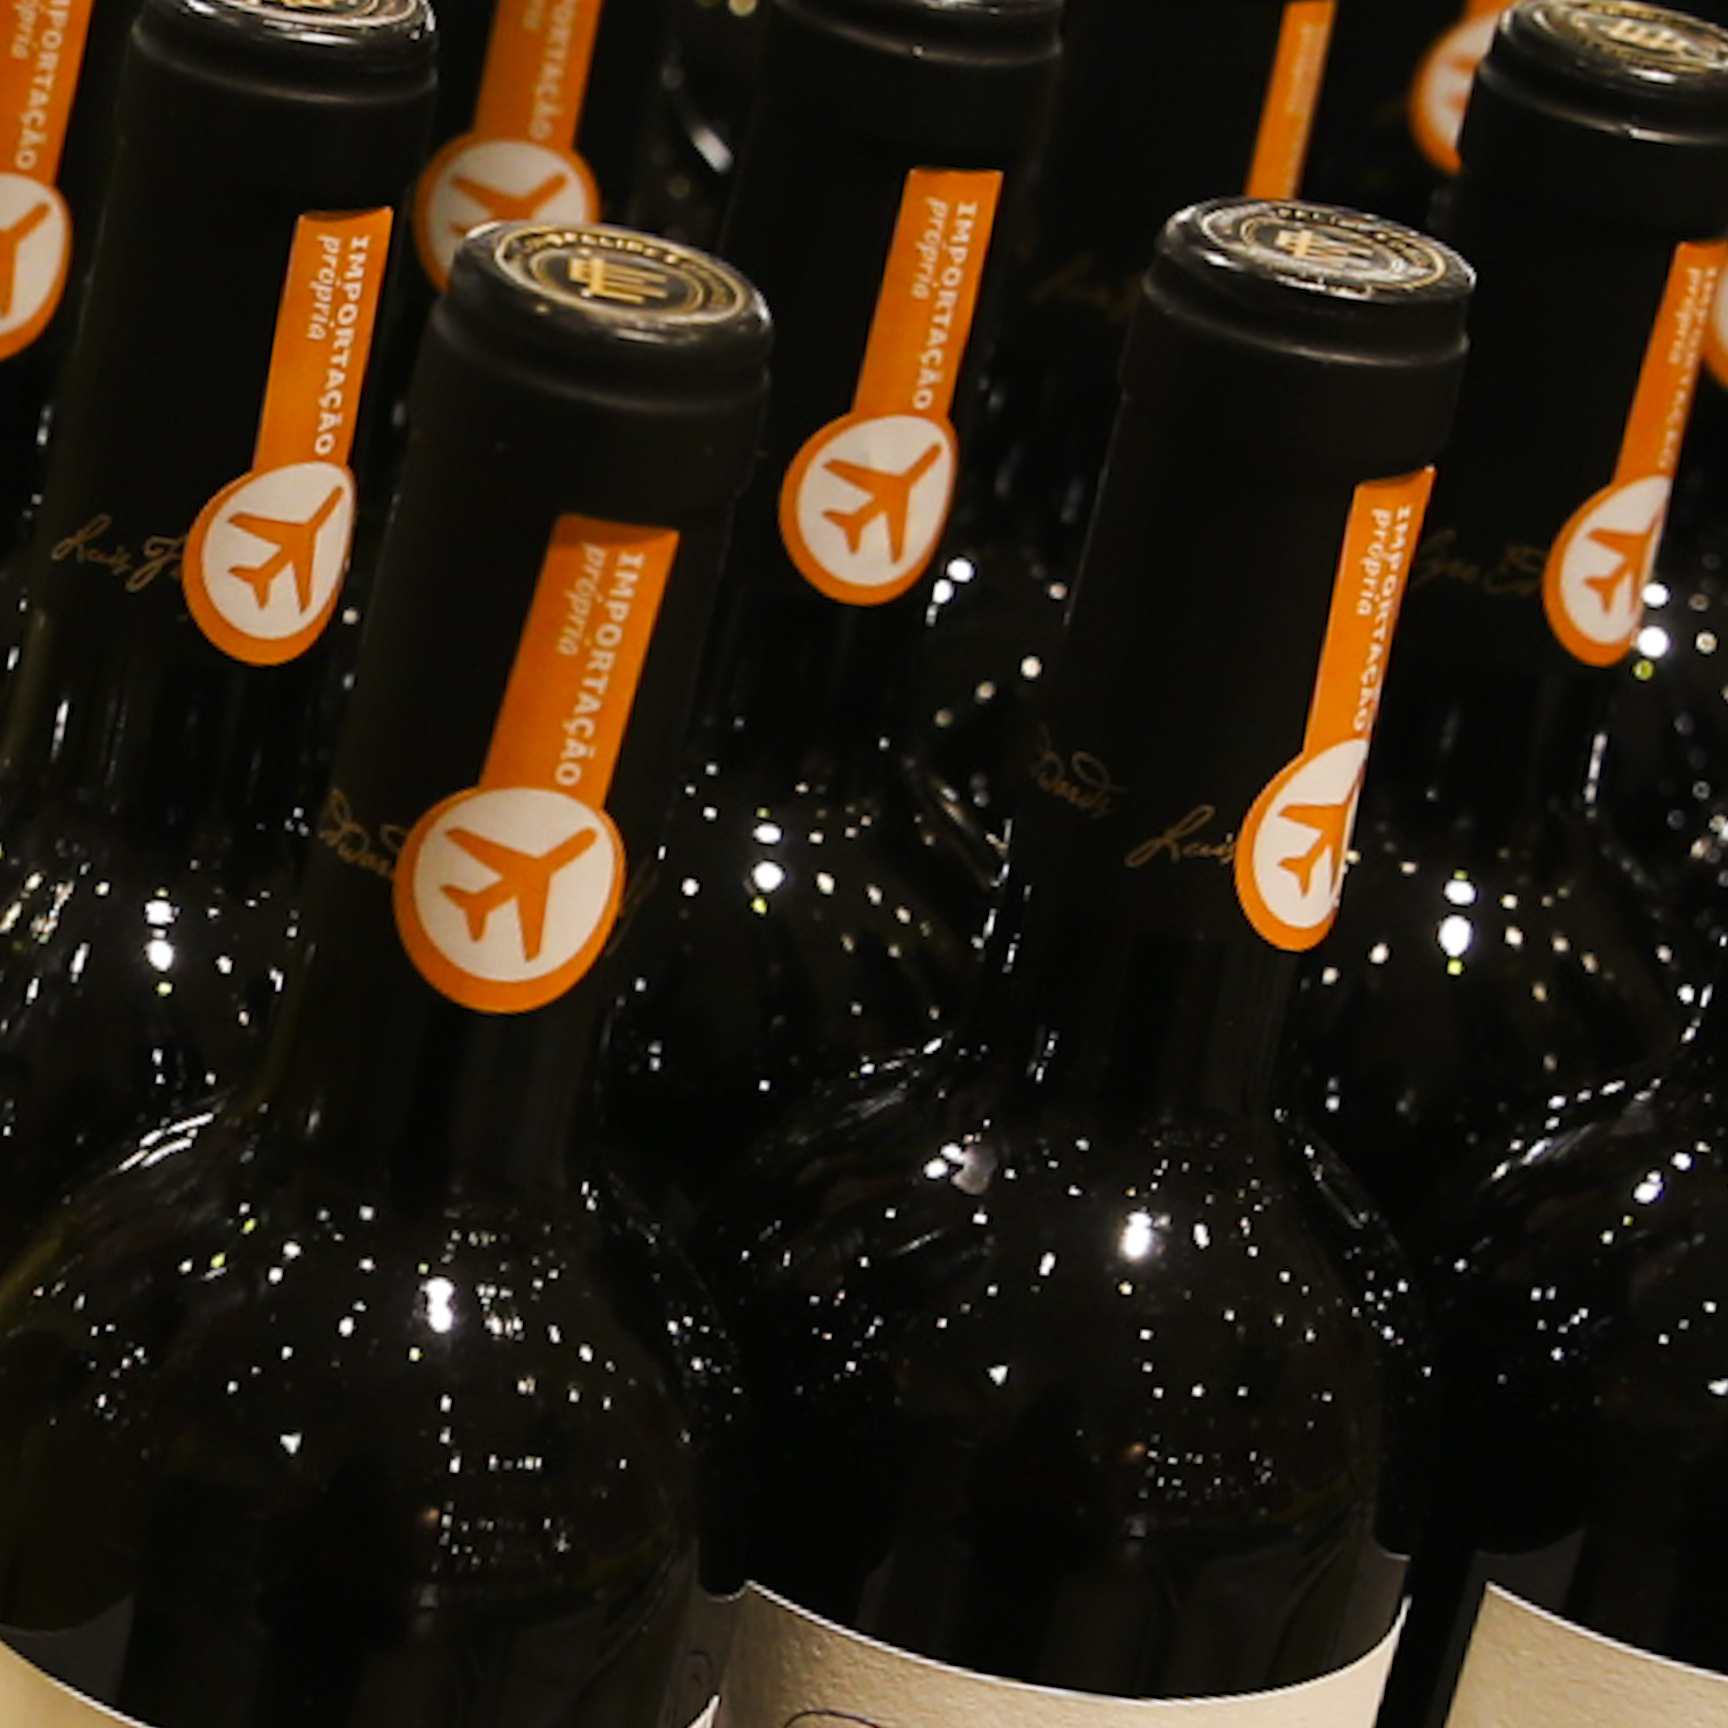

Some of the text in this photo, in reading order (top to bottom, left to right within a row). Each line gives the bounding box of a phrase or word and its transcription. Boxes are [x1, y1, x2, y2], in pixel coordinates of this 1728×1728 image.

[306, 233, 342, 341] própria
[911, 196, 949, 300] própria
[314, 233, 371, 456] IMPORTAÇÃO
[912, 201, 978, 410] IMPORTAÇÃO
[556, 543, 607, 656] própria
[1356, 508, 1393, 616] própria
[554, 550, 645, 786] IMPORTAÇÃO
